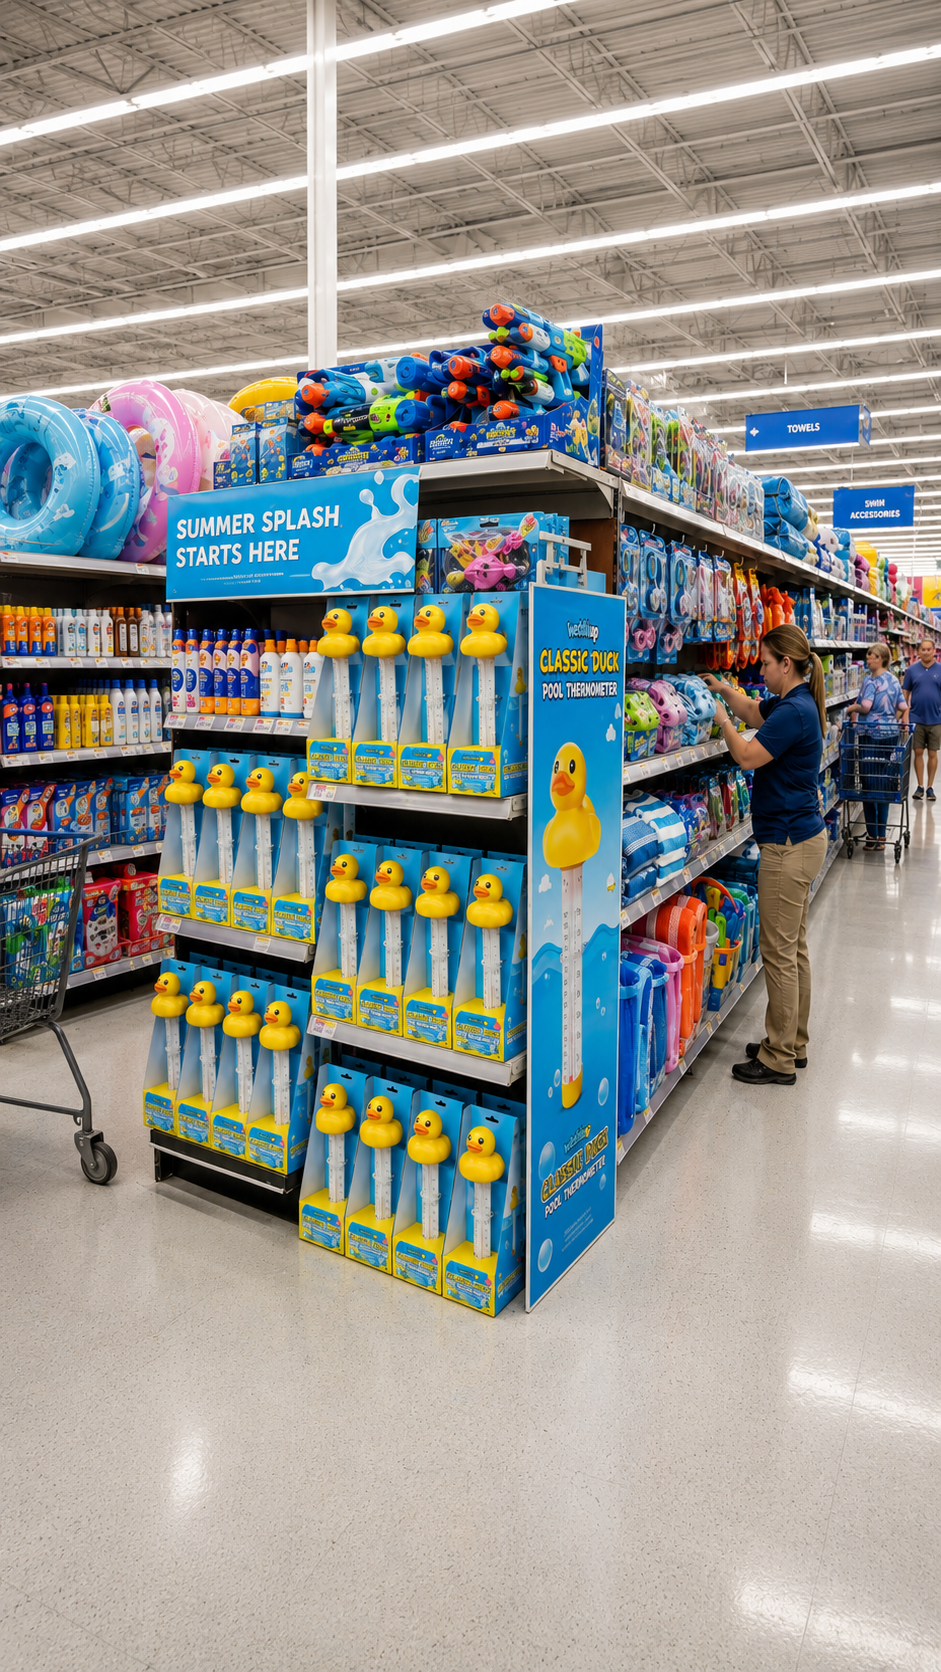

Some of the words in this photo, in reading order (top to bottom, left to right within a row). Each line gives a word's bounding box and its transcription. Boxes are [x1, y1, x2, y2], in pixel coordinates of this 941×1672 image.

[786, 422, 821, 434] TOWELS
[864, 499, 886, 508] SWIM
[176, 513, 256, 540] SUMMER
[261, 504, 340, 533] SPLASH
[175, 542, 242, 568] STARTS
[249, 538, 300, 563] HERE
[540, 648, 589, 674] CLASSIC
[591, 650, 620, 674] DUCK
[542, 681, 564, 701] POOL
[566, 681, 618, 699] THERMOMETER
